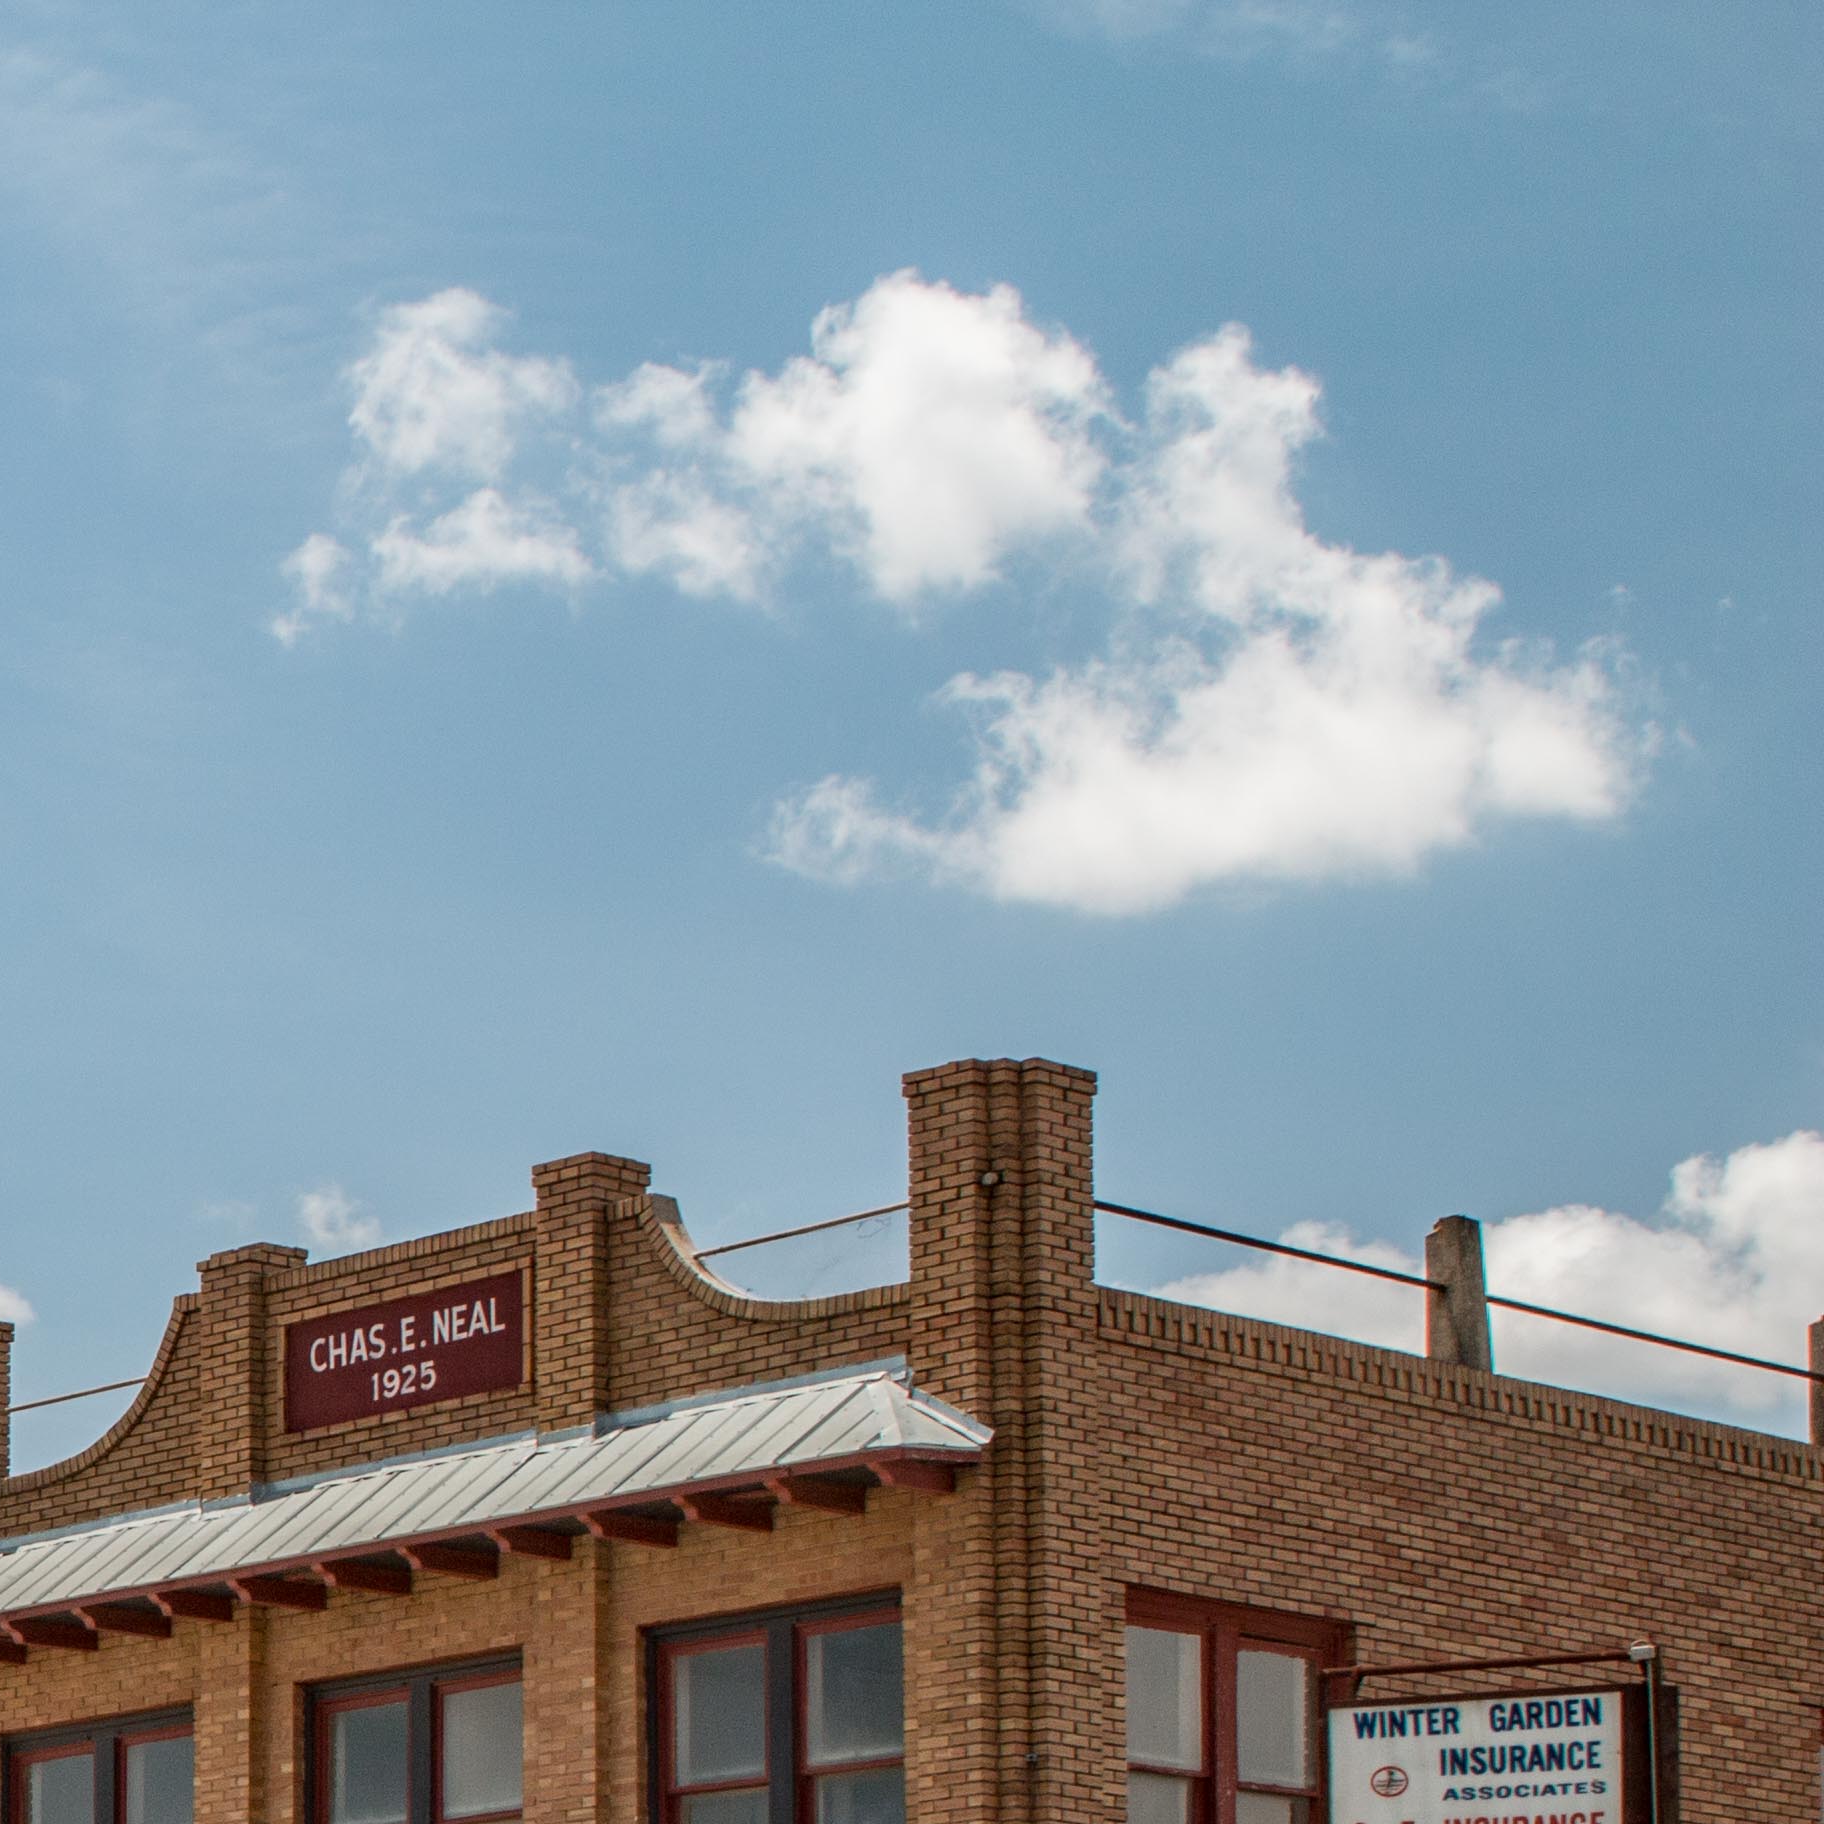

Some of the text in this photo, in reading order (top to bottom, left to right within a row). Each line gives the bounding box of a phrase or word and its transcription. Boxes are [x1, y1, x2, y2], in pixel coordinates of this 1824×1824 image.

[432, 1297, 506, 1345] NEAL
[371, 1359, 437, 1402] 1925
[1353, 1697, 1602, 1740] WINTER GARDEN
[1440, 1740, 1602, 1777] INSURANCE
[1442, 1780, 1607, 1801] ASSOCIATES
